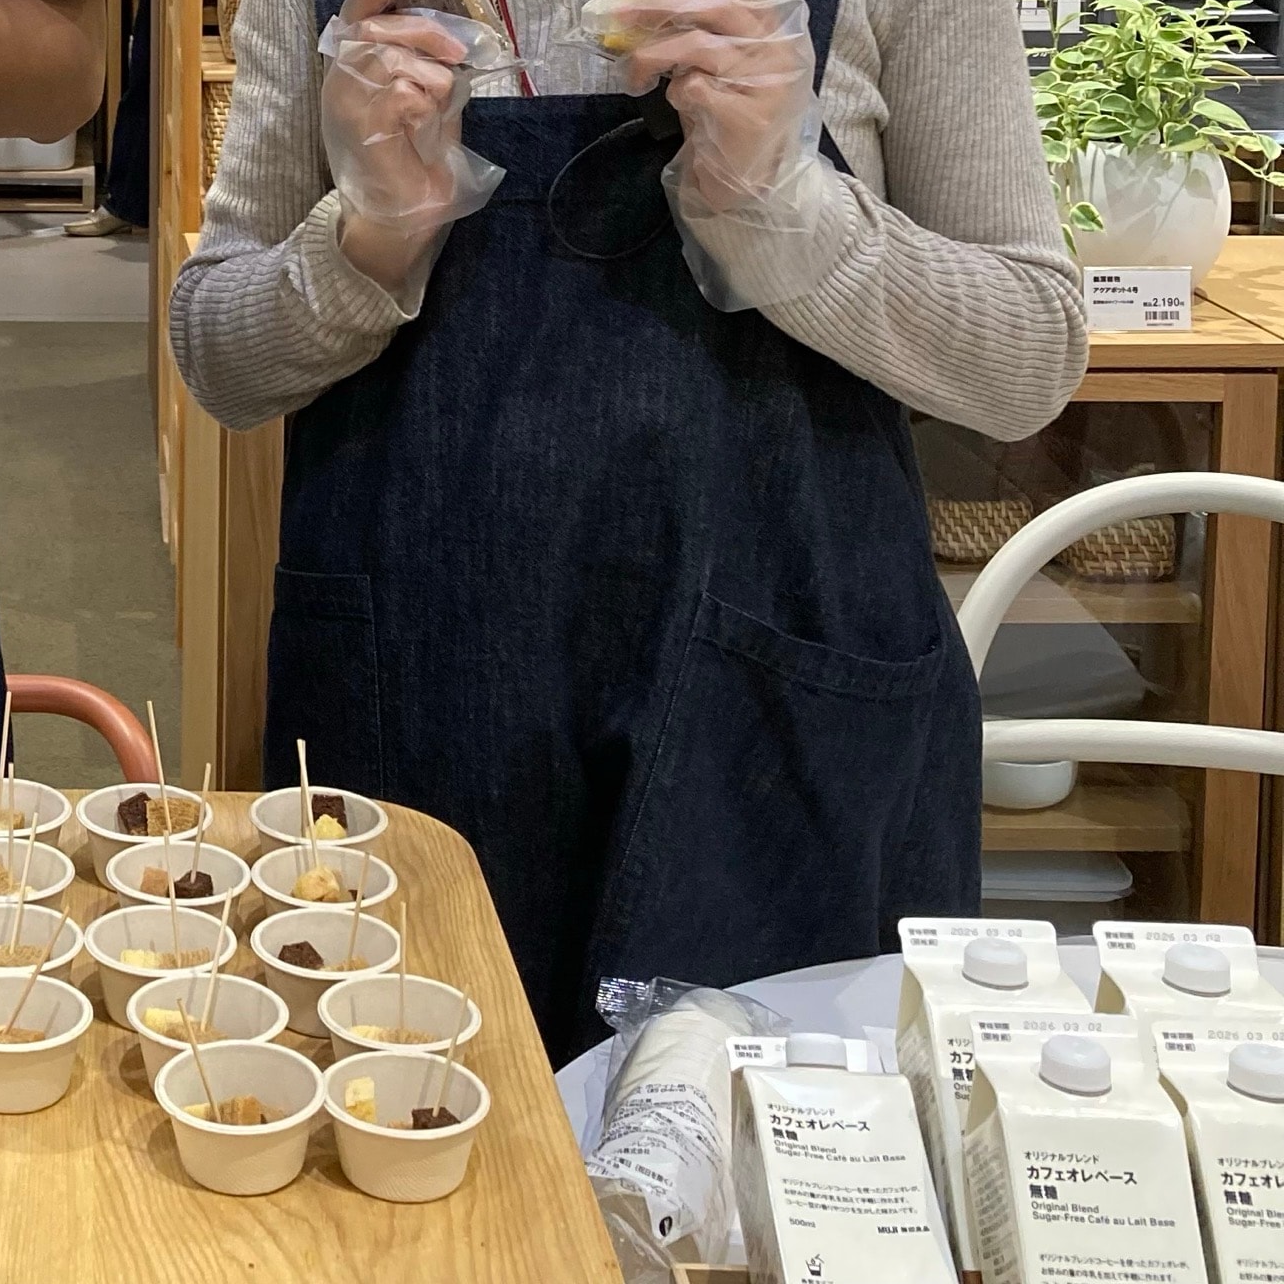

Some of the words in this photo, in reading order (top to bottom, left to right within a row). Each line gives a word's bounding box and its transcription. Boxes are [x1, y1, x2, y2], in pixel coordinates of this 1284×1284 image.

[766, 1102, 836, 1116] オリジナルブレンド
[769, 1113, 871, 1132] カフェオレベース
[772, 1127, 799, 1142] 無糖
[773, 1139, 809, 1152] Original
[810, 1144, 837, 1154] Blend
[826, 1152, 848, 1163] Café
[849, 1155, 862, 1163] au
[863, 1153, 881, 1163] Lait
[882, 1154, 906, 1162] Base
[1023, 1150, 1100, 1165] オリジナルブレンド
[1026, 1165, 1138, 1185] カフェオレベース
[1029, 1184, 1059, 1201] 無糖
[1223, 1189, 1254, 1207] 無糖
[1031, 1200, 1069, 1214] Original
[1071, 1203, 1100, 1214] Blend
[1226, 1206, 1265, 1220] Original
[1088, 1213, 1111, 1225] Café
[1113, 1218, 1126, 1226] au
[1127, 1216, 1148, 1227] Lait
[1149, 1218, 1176, 1228] Base
[876, 1225, 899, 1235] MUJI
